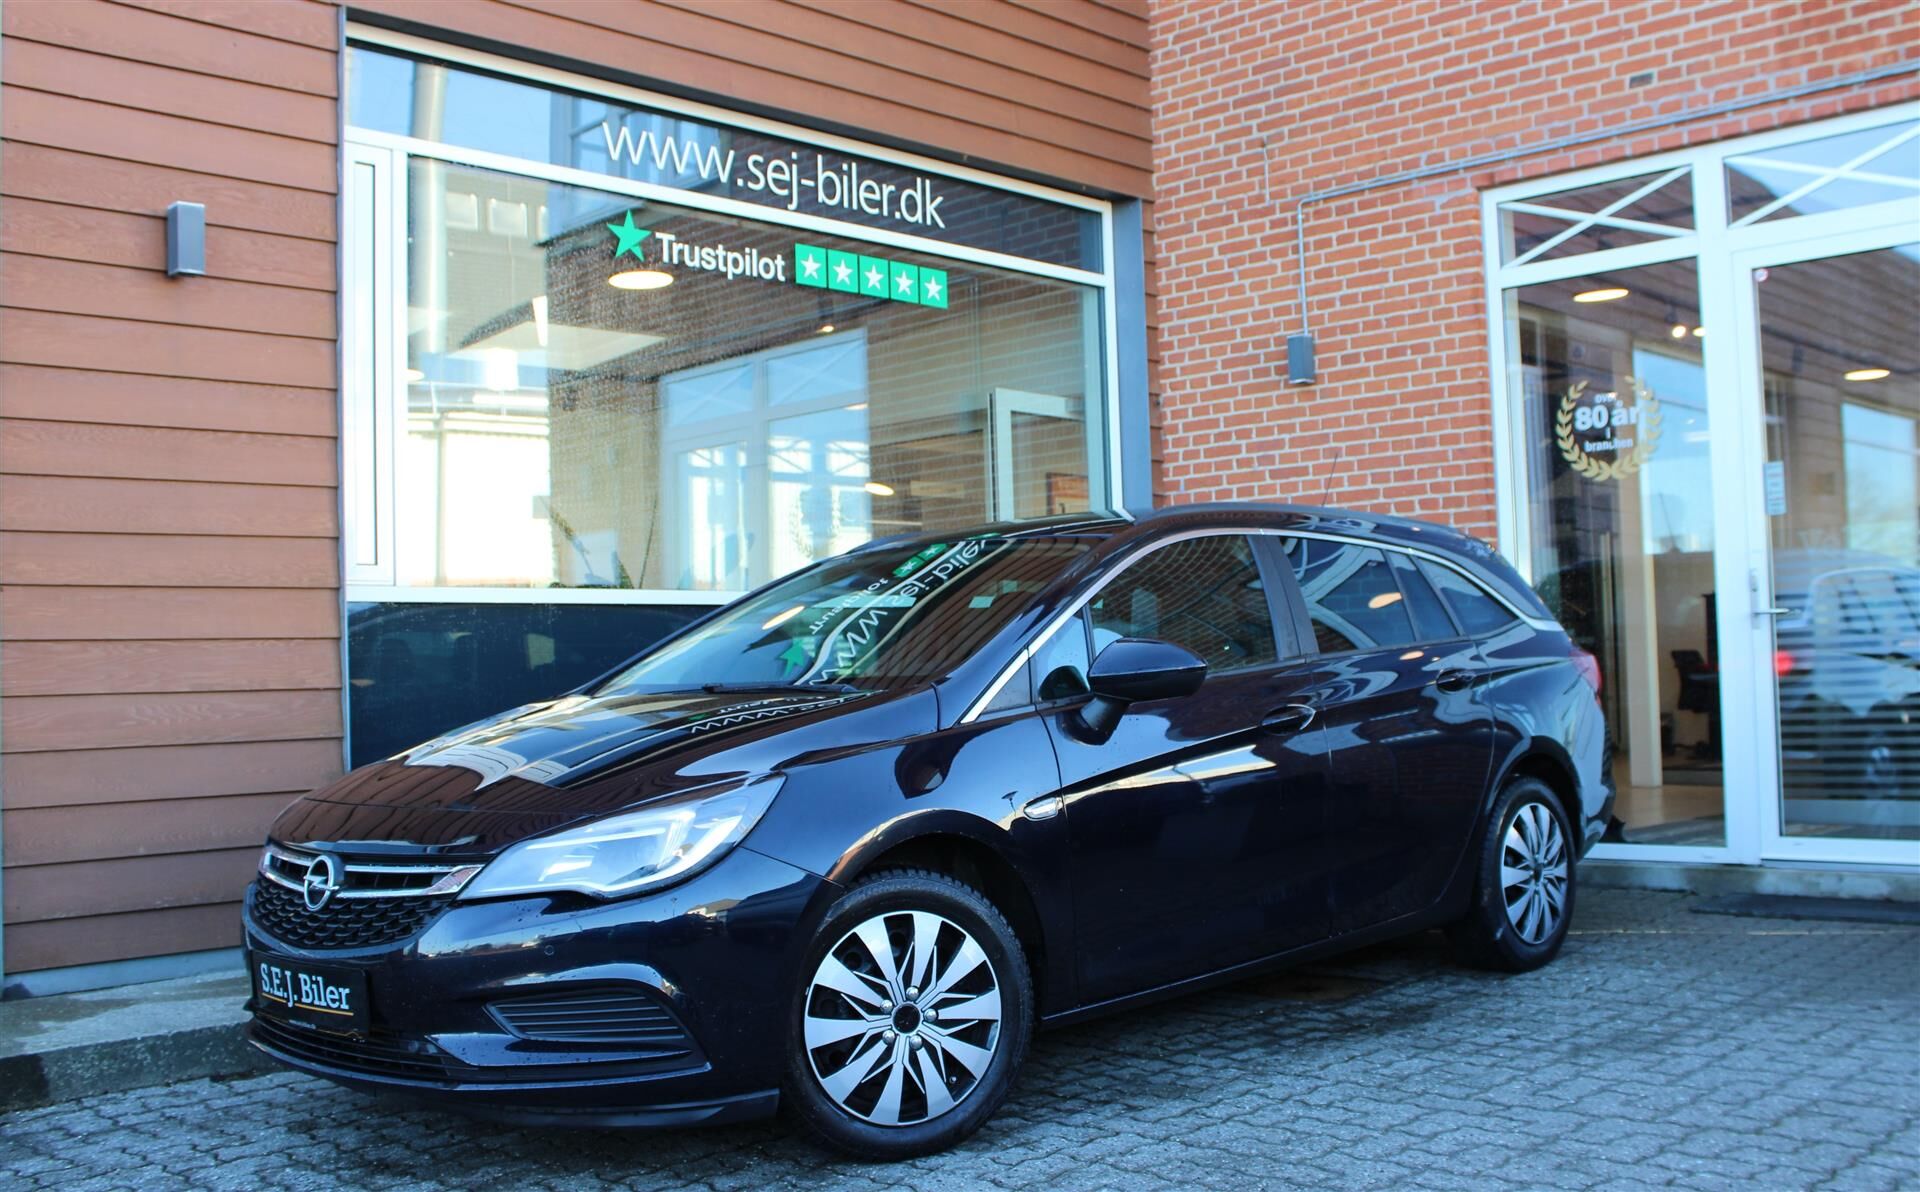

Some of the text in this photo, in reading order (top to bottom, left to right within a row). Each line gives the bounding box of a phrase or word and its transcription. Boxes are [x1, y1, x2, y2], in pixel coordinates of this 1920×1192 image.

[602, 121, 945, 228] www.sej-biler.dk
[655, 232, 785, 281] Trustpilot
[1574, 400, 1639, 431] 80 år
[260, 963, 350, 1009] S.E.J. Biler
